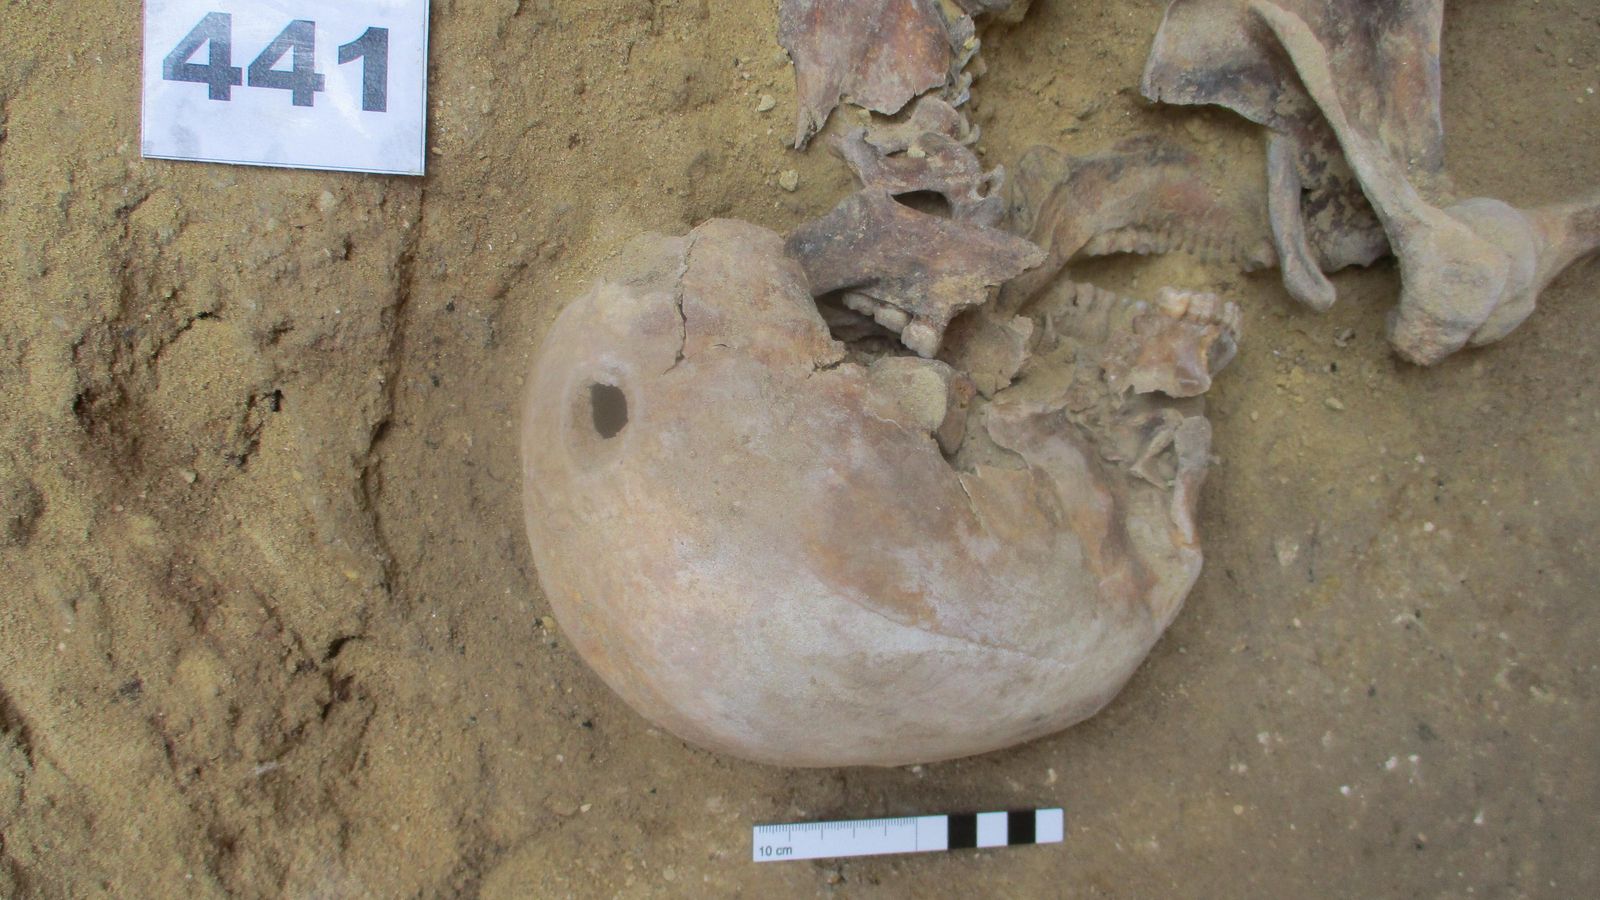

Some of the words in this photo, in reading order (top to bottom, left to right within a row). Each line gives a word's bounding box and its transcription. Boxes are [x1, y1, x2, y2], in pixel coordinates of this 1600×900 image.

[162, 11, 389, 113] 441
[759, 845, 772, 856] 10
[775, 845, 792, 855] cm
